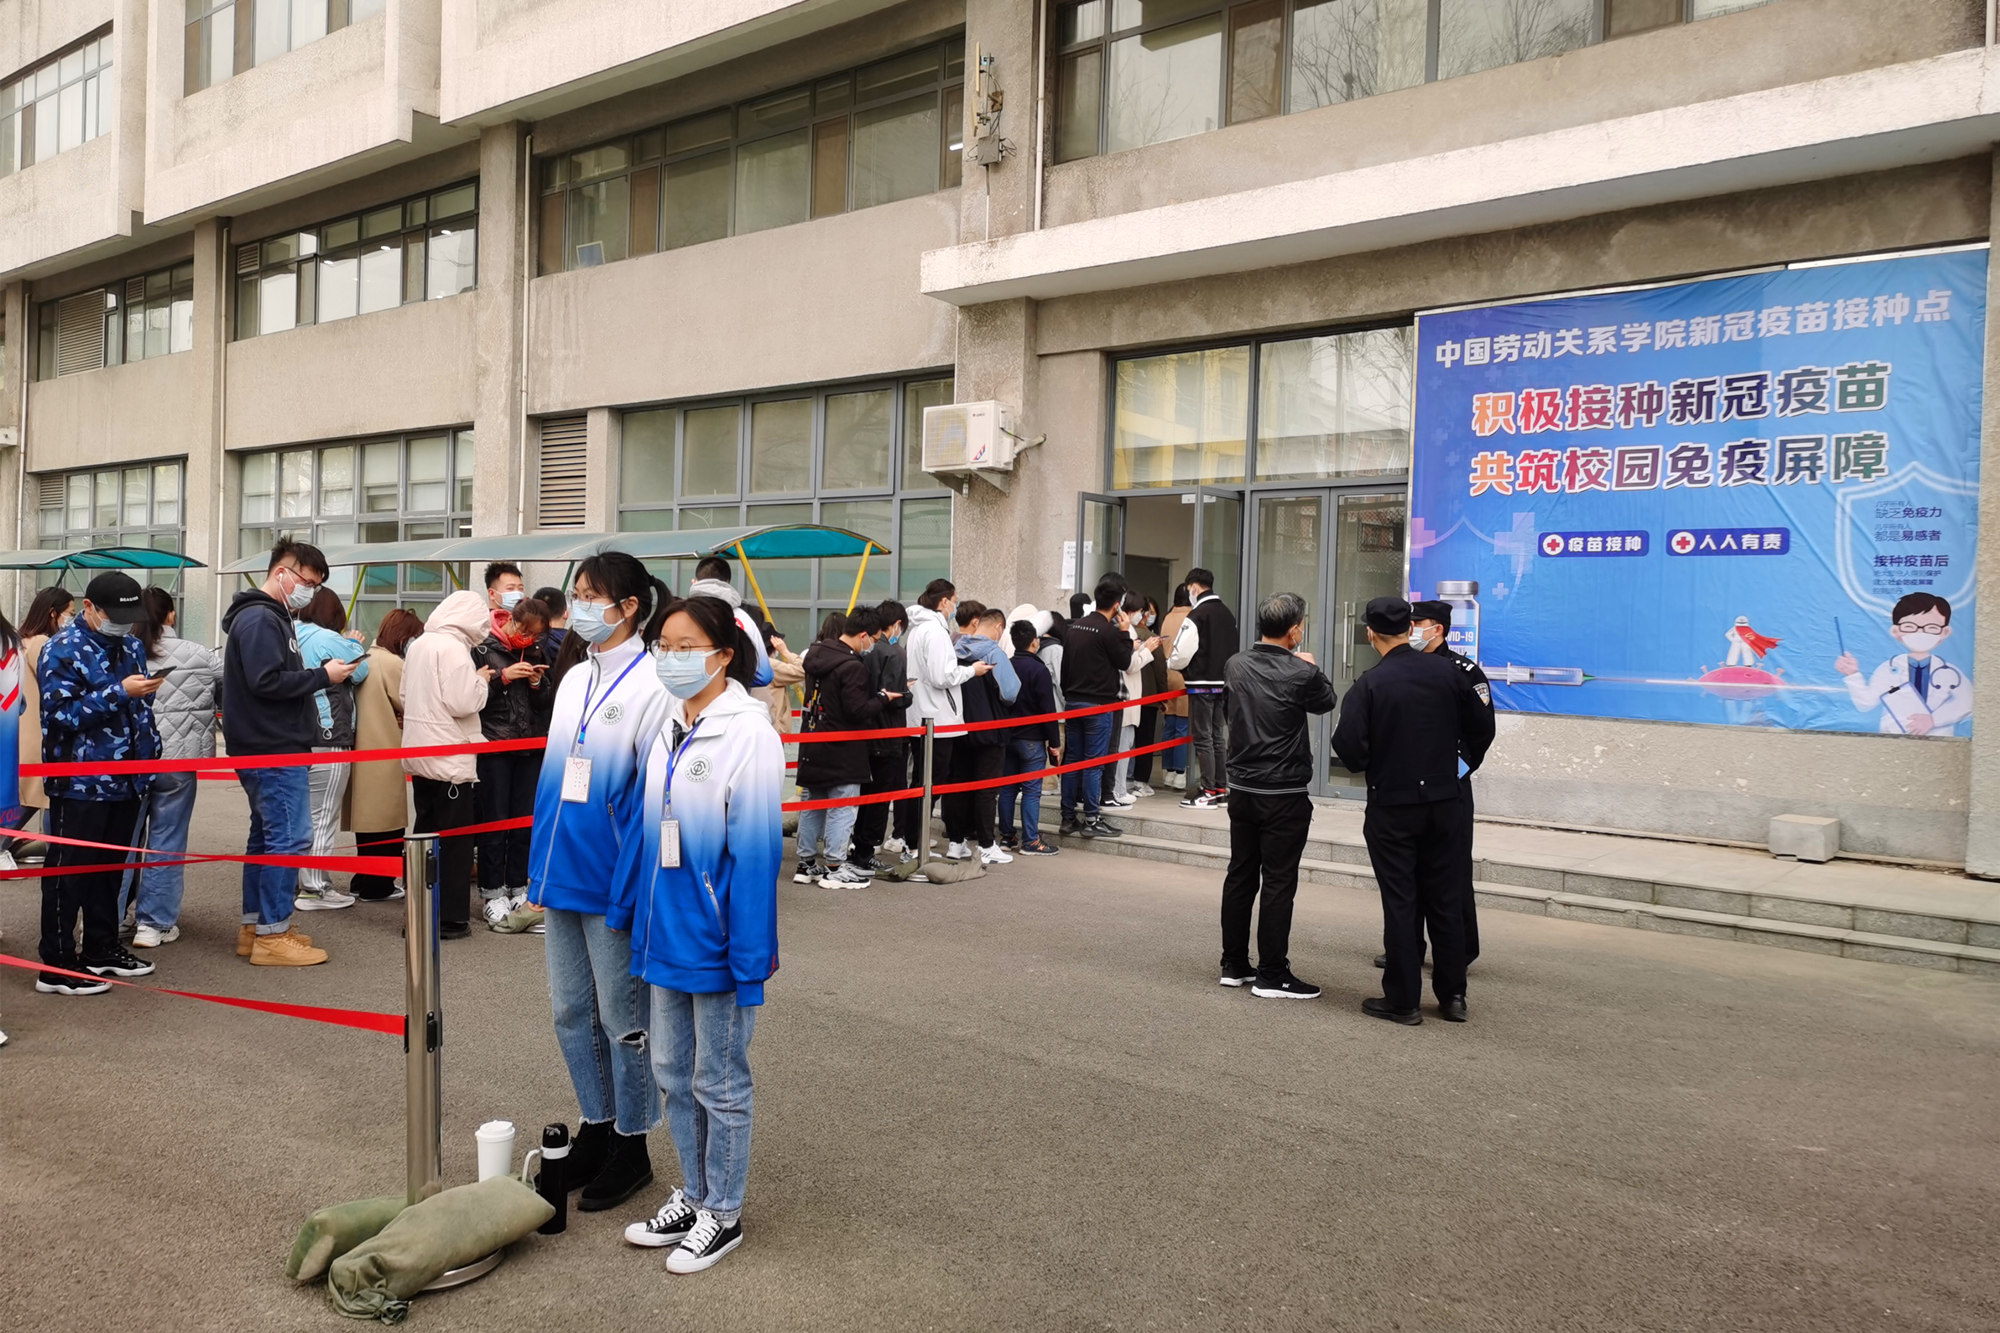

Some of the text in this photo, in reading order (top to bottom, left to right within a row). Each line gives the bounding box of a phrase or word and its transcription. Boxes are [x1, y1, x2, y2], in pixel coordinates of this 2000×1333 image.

[1435, 289, 1952, 368] 中国劳动关系学院新冠疫苗接种点
[1471, 360, 1892, 437] 积极接种新冠疫苗
[1469, 431, 1889, 497] 共筑校园免疫屏障
[1875, 507, 1942, 519] 缺乏免疫力
[1568, 536, 1642, 552] 疫苗接种
[1699, 533, 1782, 551] 人人有责
[1874, 530, 1942, 542] 都是易感者
[1873, 555, 1949, 567] 接种疫苗后
[1445, 631, 1474, 642] VID-19
